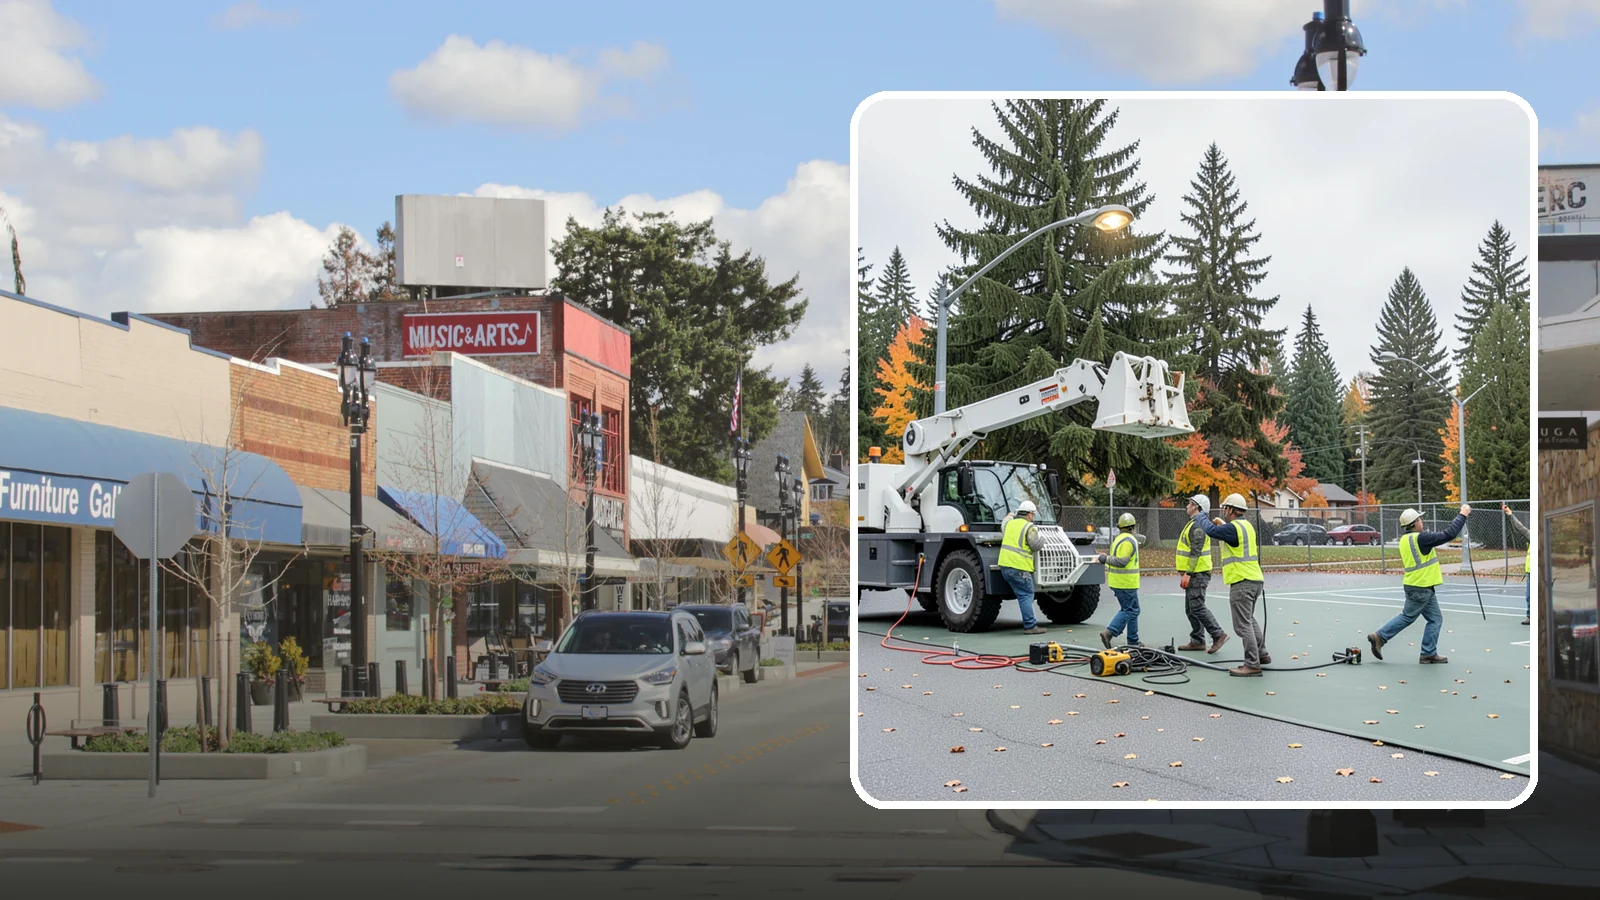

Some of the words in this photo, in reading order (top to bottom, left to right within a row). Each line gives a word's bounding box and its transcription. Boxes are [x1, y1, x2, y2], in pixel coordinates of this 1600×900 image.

[1540, 427, 1577, 437] UGA
[0, 472, 79, 515] Furniture
[89, 482, 121, 519] Gal
[453, 563, 479, 574] SUSHI
